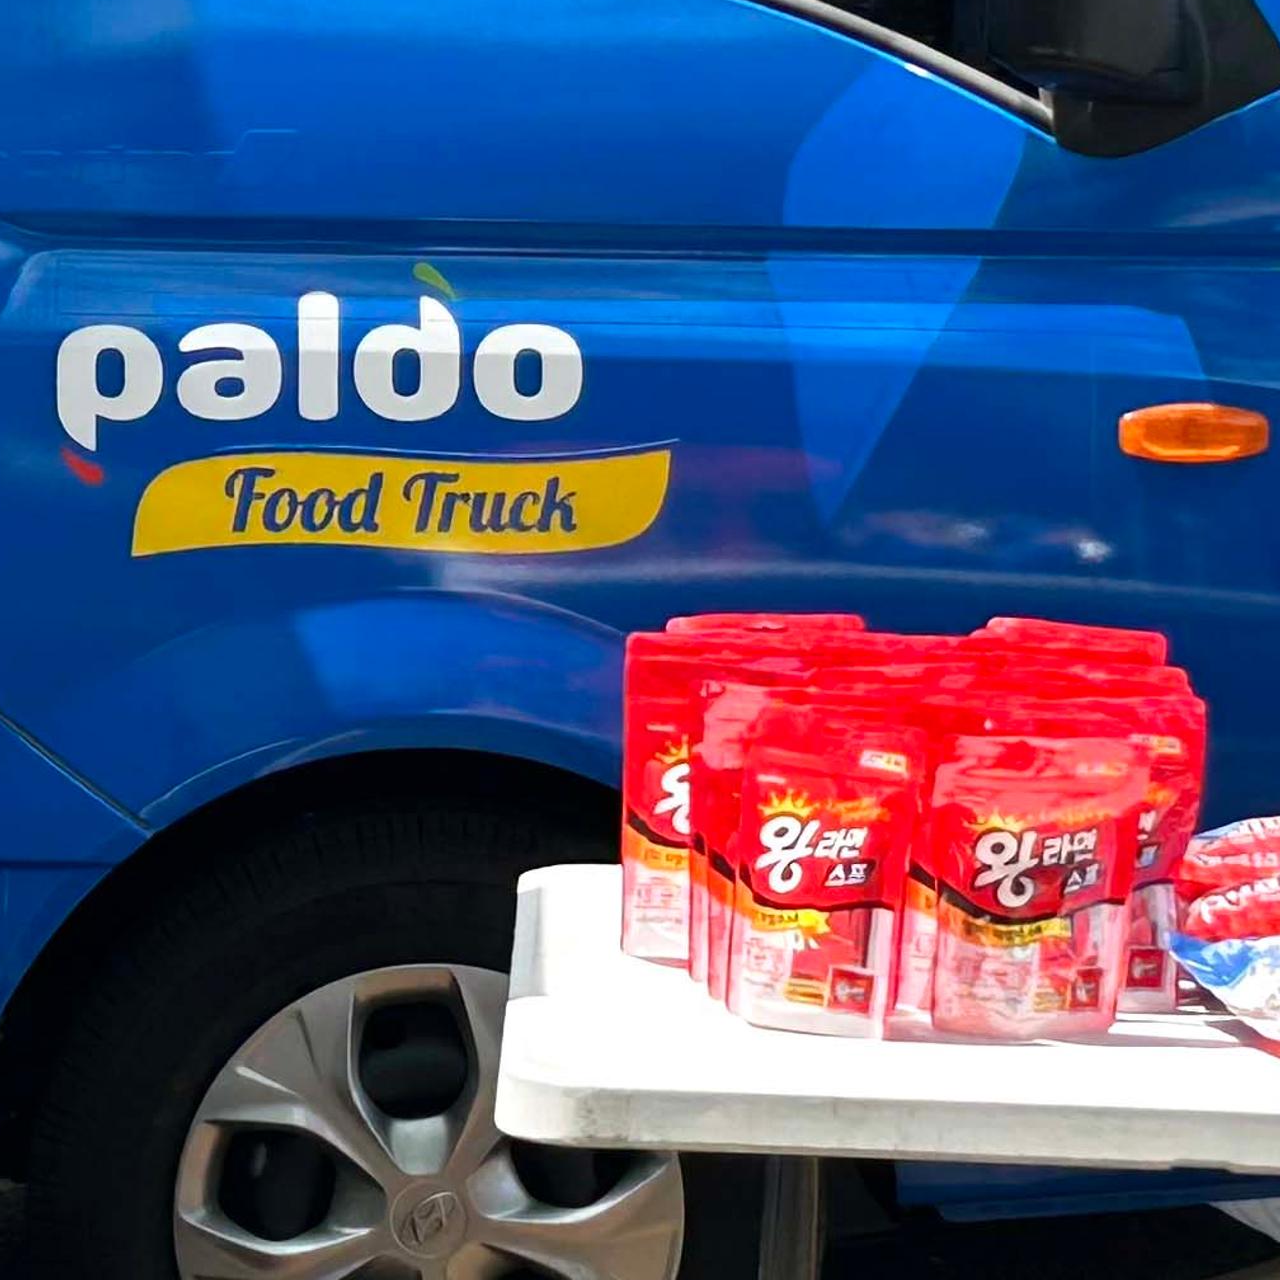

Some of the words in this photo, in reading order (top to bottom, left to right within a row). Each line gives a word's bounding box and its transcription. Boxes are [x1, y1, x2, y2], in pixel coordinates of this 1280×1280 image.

[56, 290, 584, 452] paldo
[223, 466, 384, 534] Food
[401, 472, 578, 534] Truck
